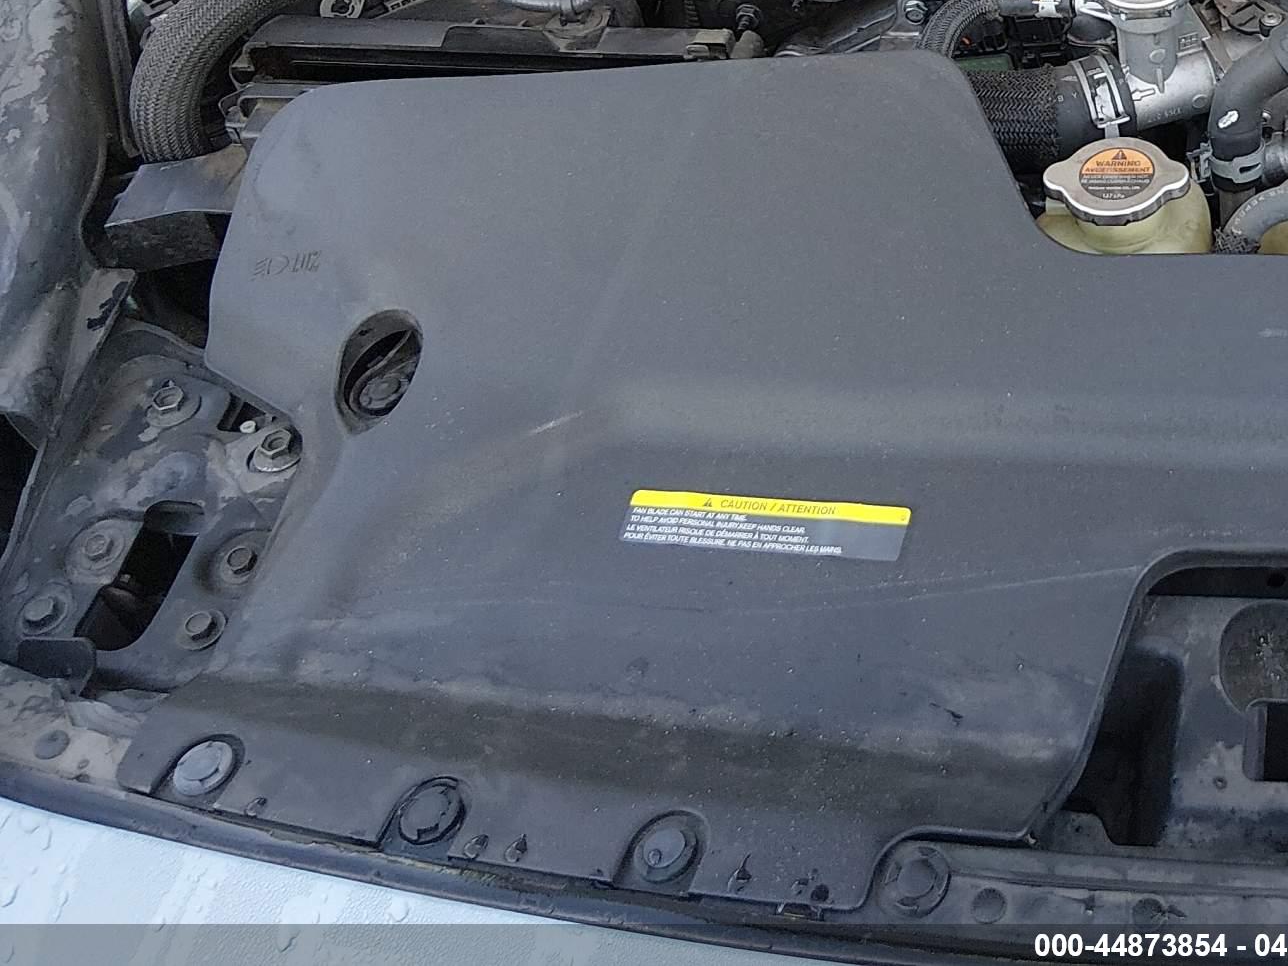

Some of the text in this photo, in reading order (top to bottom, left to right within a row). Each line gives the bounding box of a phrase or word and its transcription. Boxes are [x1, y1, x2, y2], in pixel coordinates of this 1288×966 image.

[670, 508, 684, 516] CAN
[720, 499, 768, 511] CAUTION
[777, 503, 836, 515] ATTENTION
[631, 514, 641, 522] TO
[640, 515, 659, 523] HELP
[658, 516, 679, 524] AVOID
[679, 517, 714, 527] PERSONAL
[756, 523, 781, 532] HANDS
[626, 523, 637, 531] LE
[637, 524, 678, 533] VENTILATEUR
[705, 529, 717, 537] DE
[760, 533, 777, 541] TOUT
